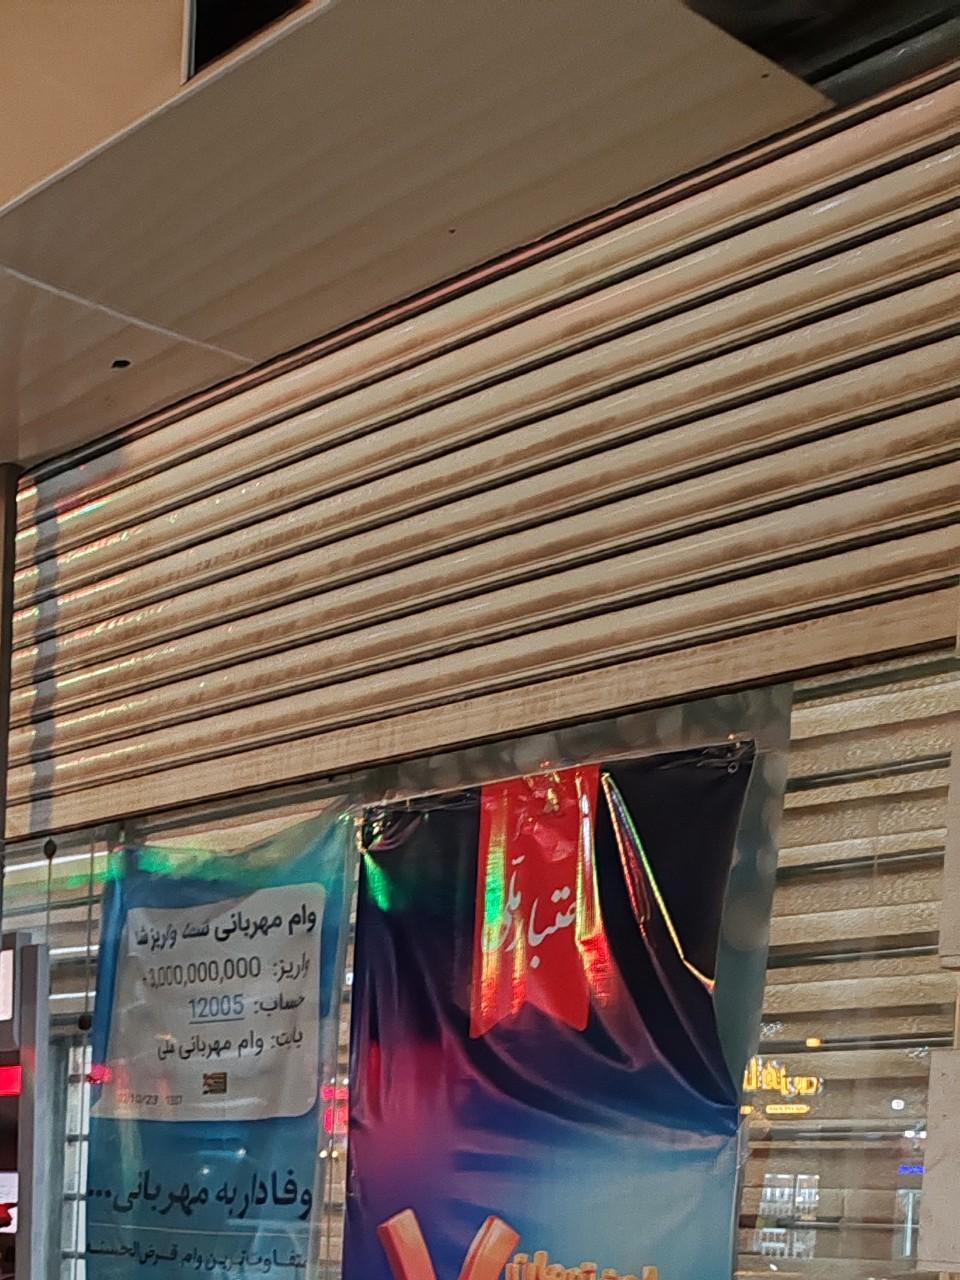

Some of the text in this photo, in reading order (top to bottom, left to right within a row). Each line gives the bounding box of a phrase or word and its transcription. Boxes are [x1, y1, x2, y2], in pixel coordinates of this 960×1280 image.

[215, 912, 282, 941] مهربانی
[288, 904, 317, 935] وام
[189, 992, 306, 1020] حساب: 12005
[179, 1035, 231, 1059] مهربانی
[238, 1030, 264, 1057] وام
[215, 1180, 238, 1215] به
[239, 1168, 313, 1220] وفادار
[181, 1248, 203, 1271] وام
